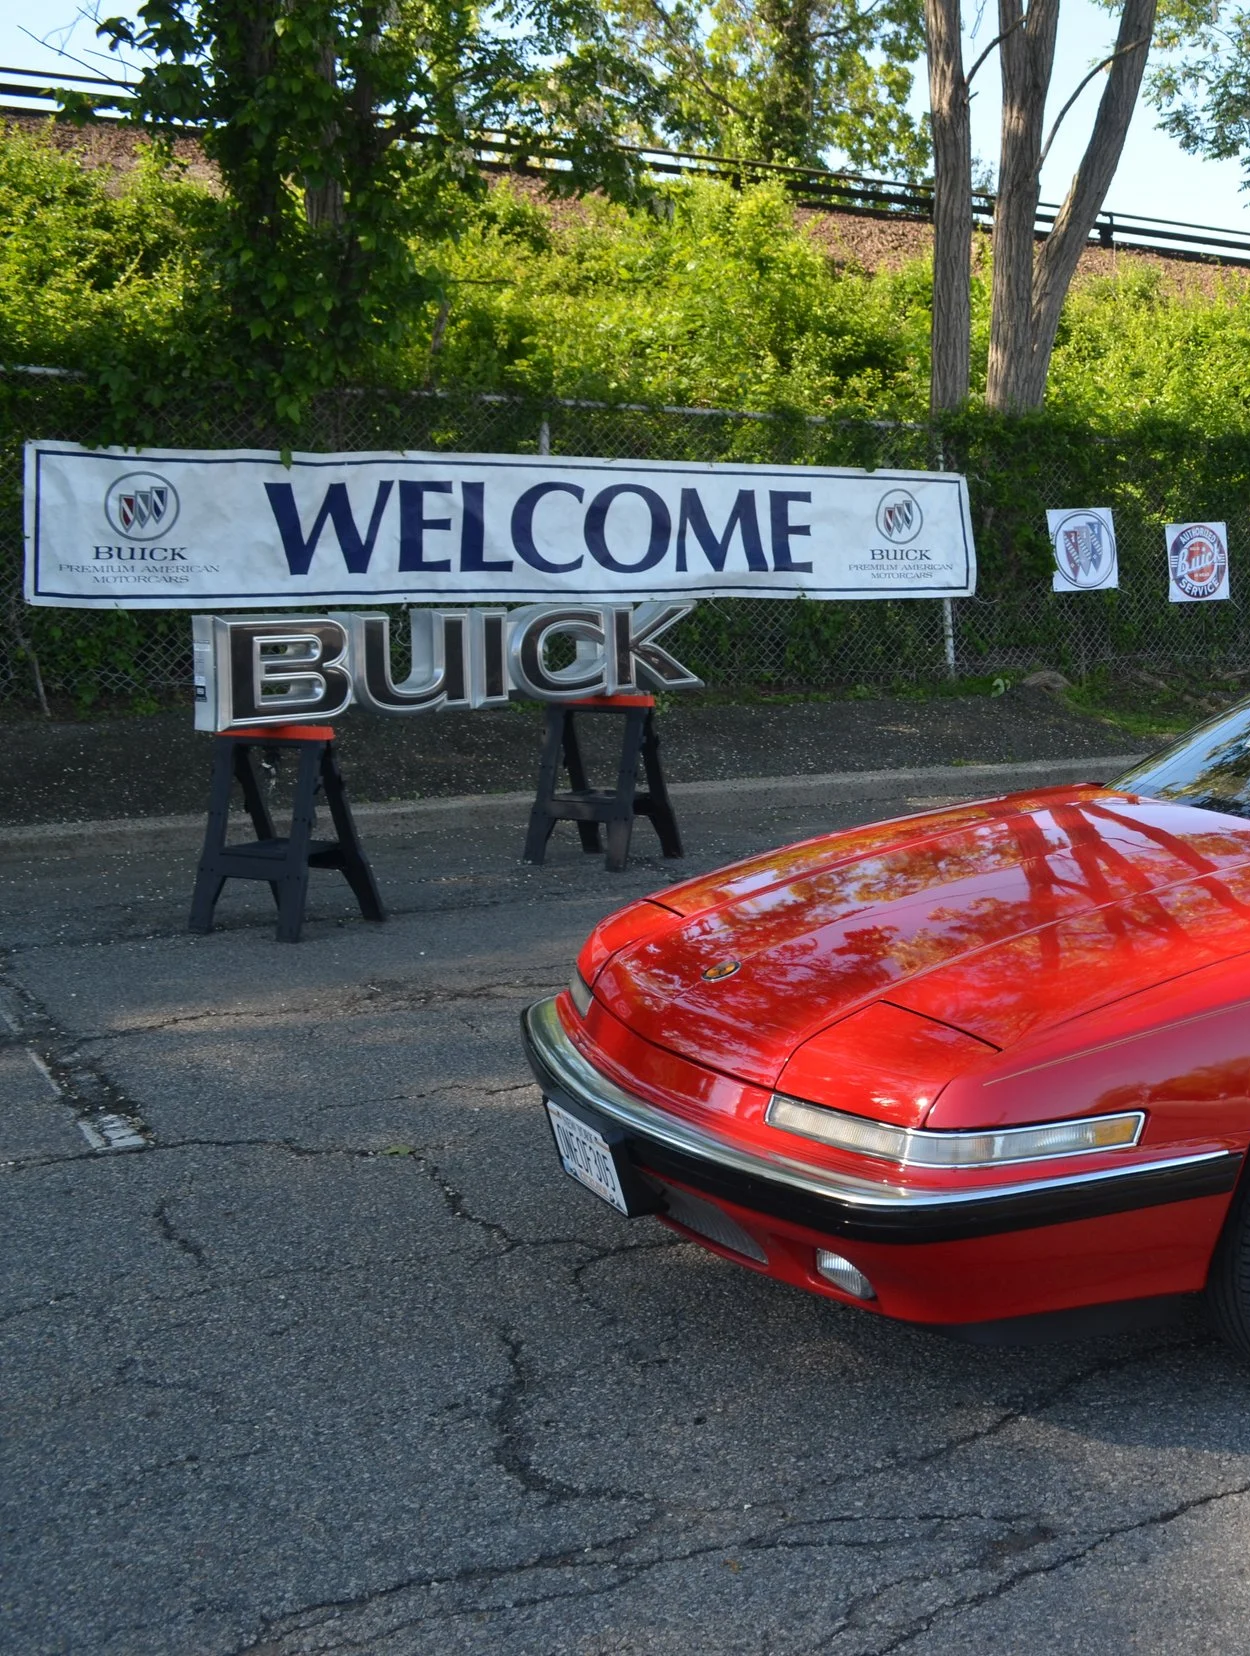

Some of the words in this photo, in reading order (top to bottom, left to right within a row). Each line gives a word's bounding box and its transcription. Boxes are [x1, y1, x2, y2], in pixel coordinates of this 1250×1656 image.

[263, 479, 813, 576] WELCOME
[1179, 527, 1217, 545] AUTHORIZED
[91, 545, 188, 561] BUICK
[869, 548, 932, 561] BUICK
[1176, 543, 1222, 577] Buick
[58, 563, 135, 573] PREMIUM
[141, 564, 220, 573] AMERICAN
[848, 563, 898, 571] PREMIUM
[901, 563, 954, 571] AMERICAN
[871, 571, 933, 579] MOTORCARS
[91, 575, 190, 584] MOTORCARS
[1179, 578, 1220, 597] SERVICE
[192, 600, 704, 733] BUICK
